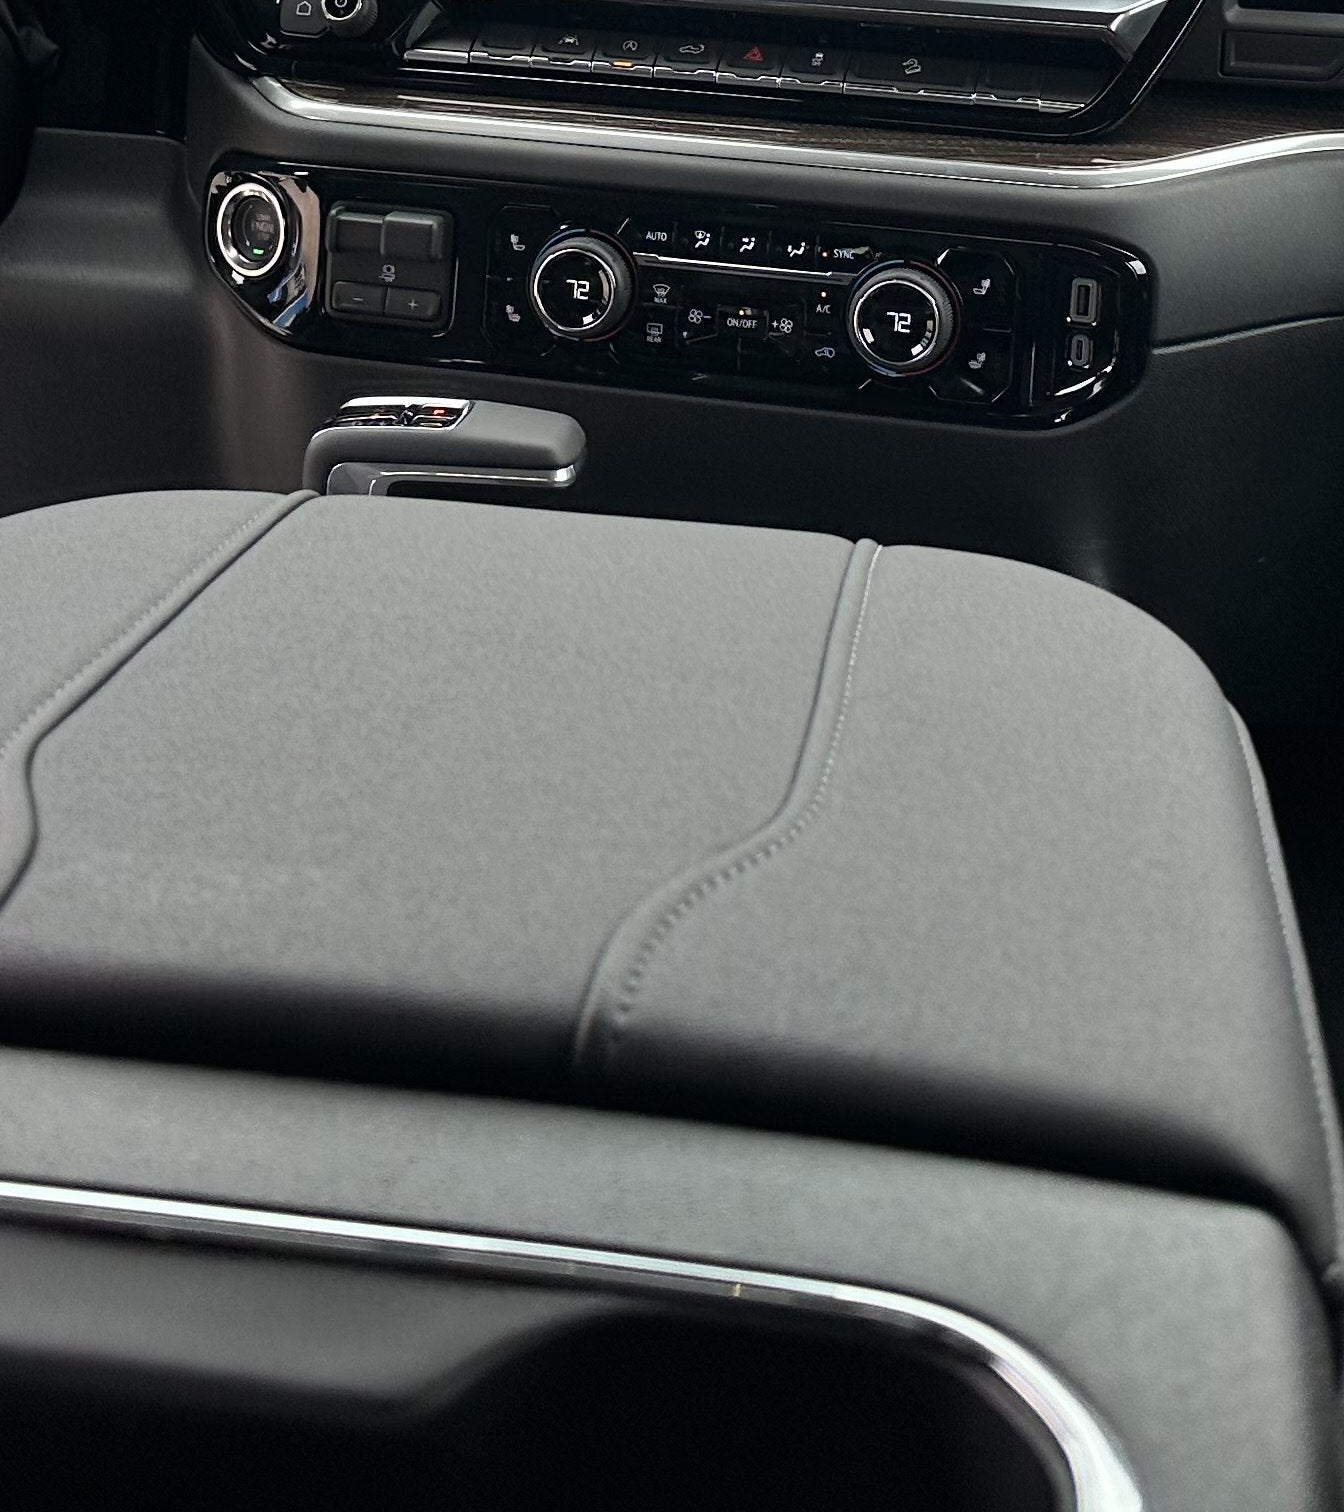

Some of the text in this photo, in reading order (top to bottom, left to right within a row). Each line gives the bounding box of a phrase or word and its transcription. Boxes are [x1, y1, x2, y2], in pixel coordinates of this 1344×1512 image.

[646, 231, 667, 242] AUTO
[833, 248, 855, 260] SYNC
[565, 279, 590, 300] 72
[816, 304, 831, 314] A/C
[726, 317, 758, 329] ON/OFF
[887, 311, 911, 333] 72
